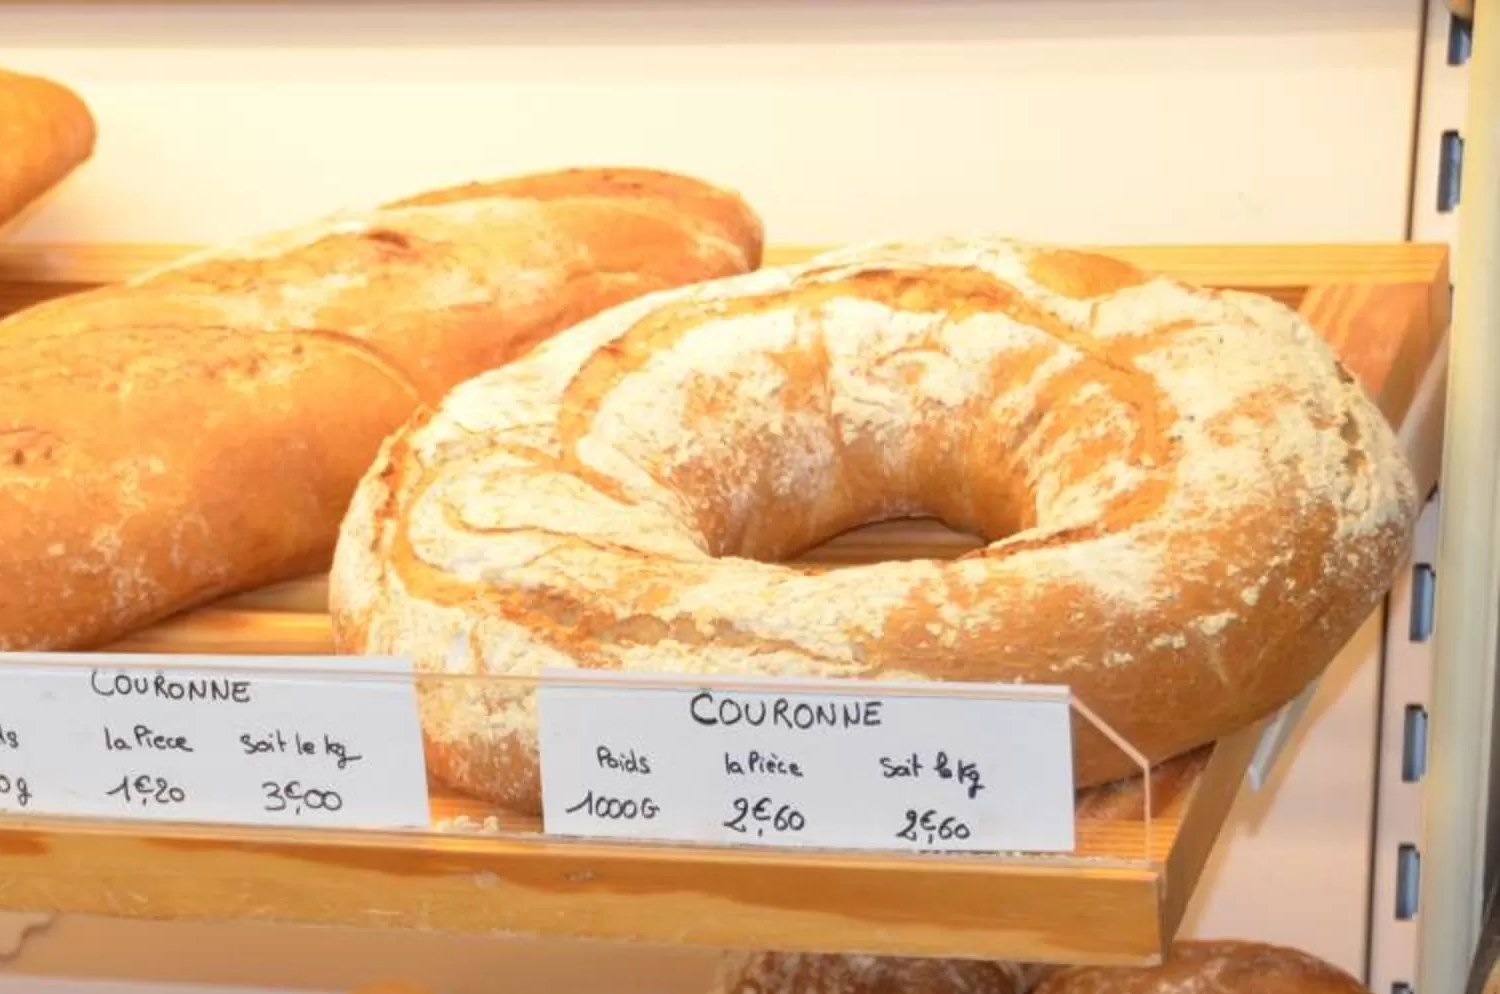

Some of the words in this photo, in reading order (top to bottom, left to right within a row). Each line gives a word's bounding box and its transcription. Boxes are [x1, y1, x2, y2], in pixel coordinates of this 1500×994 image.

[91, 669, 251, 703] COURONNE
[689, 692, 883, 729] COURONNE
[104, 726, 132, 751] la
[296, 731, 316, 756] le
[596, 745, 651, 775] Poids
[724, 751, 745, 775] la
[749, 750, 804, 777] Pièce
[565, 789, 661, 819] 1000G
